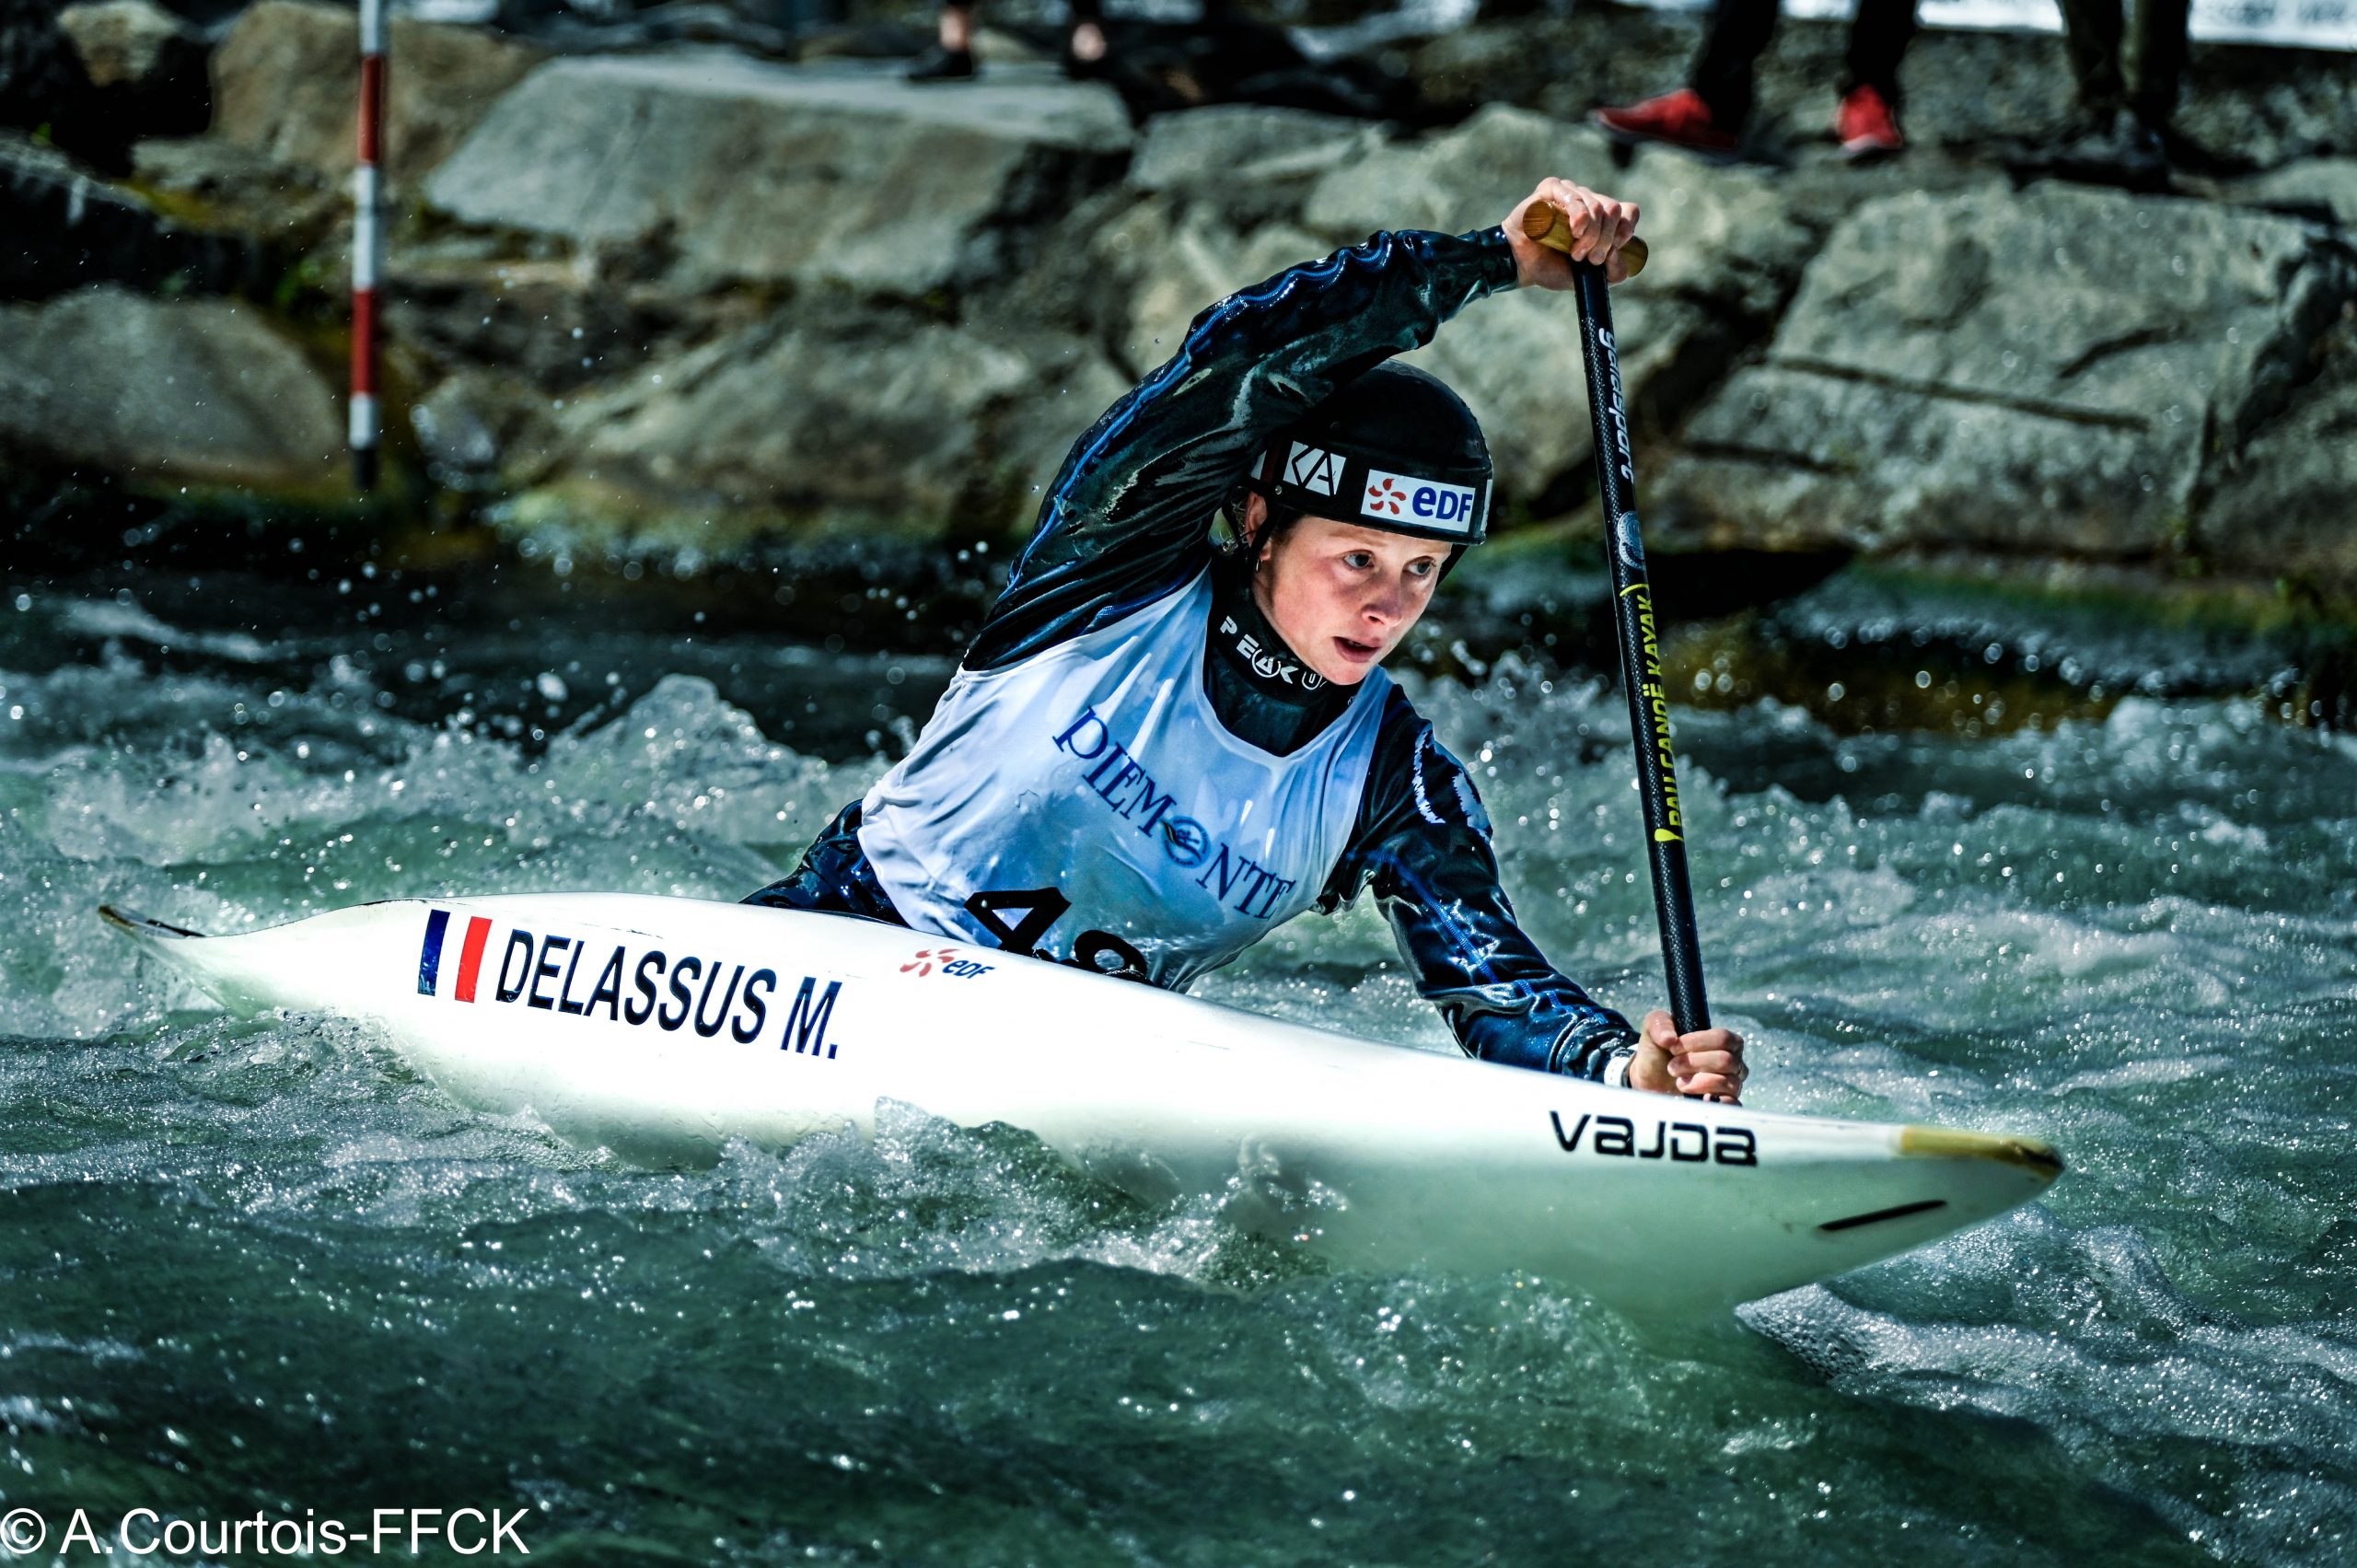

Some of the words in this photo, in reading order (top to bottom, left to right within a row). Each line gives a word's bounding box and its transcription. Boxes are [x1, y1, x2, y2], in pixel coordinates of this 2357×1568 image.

[1219, 615, 1299, 684] PEAK
[1636, 594, 1662, 676] KAYAK
[495, 928, 777, 1044] DELASSUS
[780, 976, 843, 1060] M.
